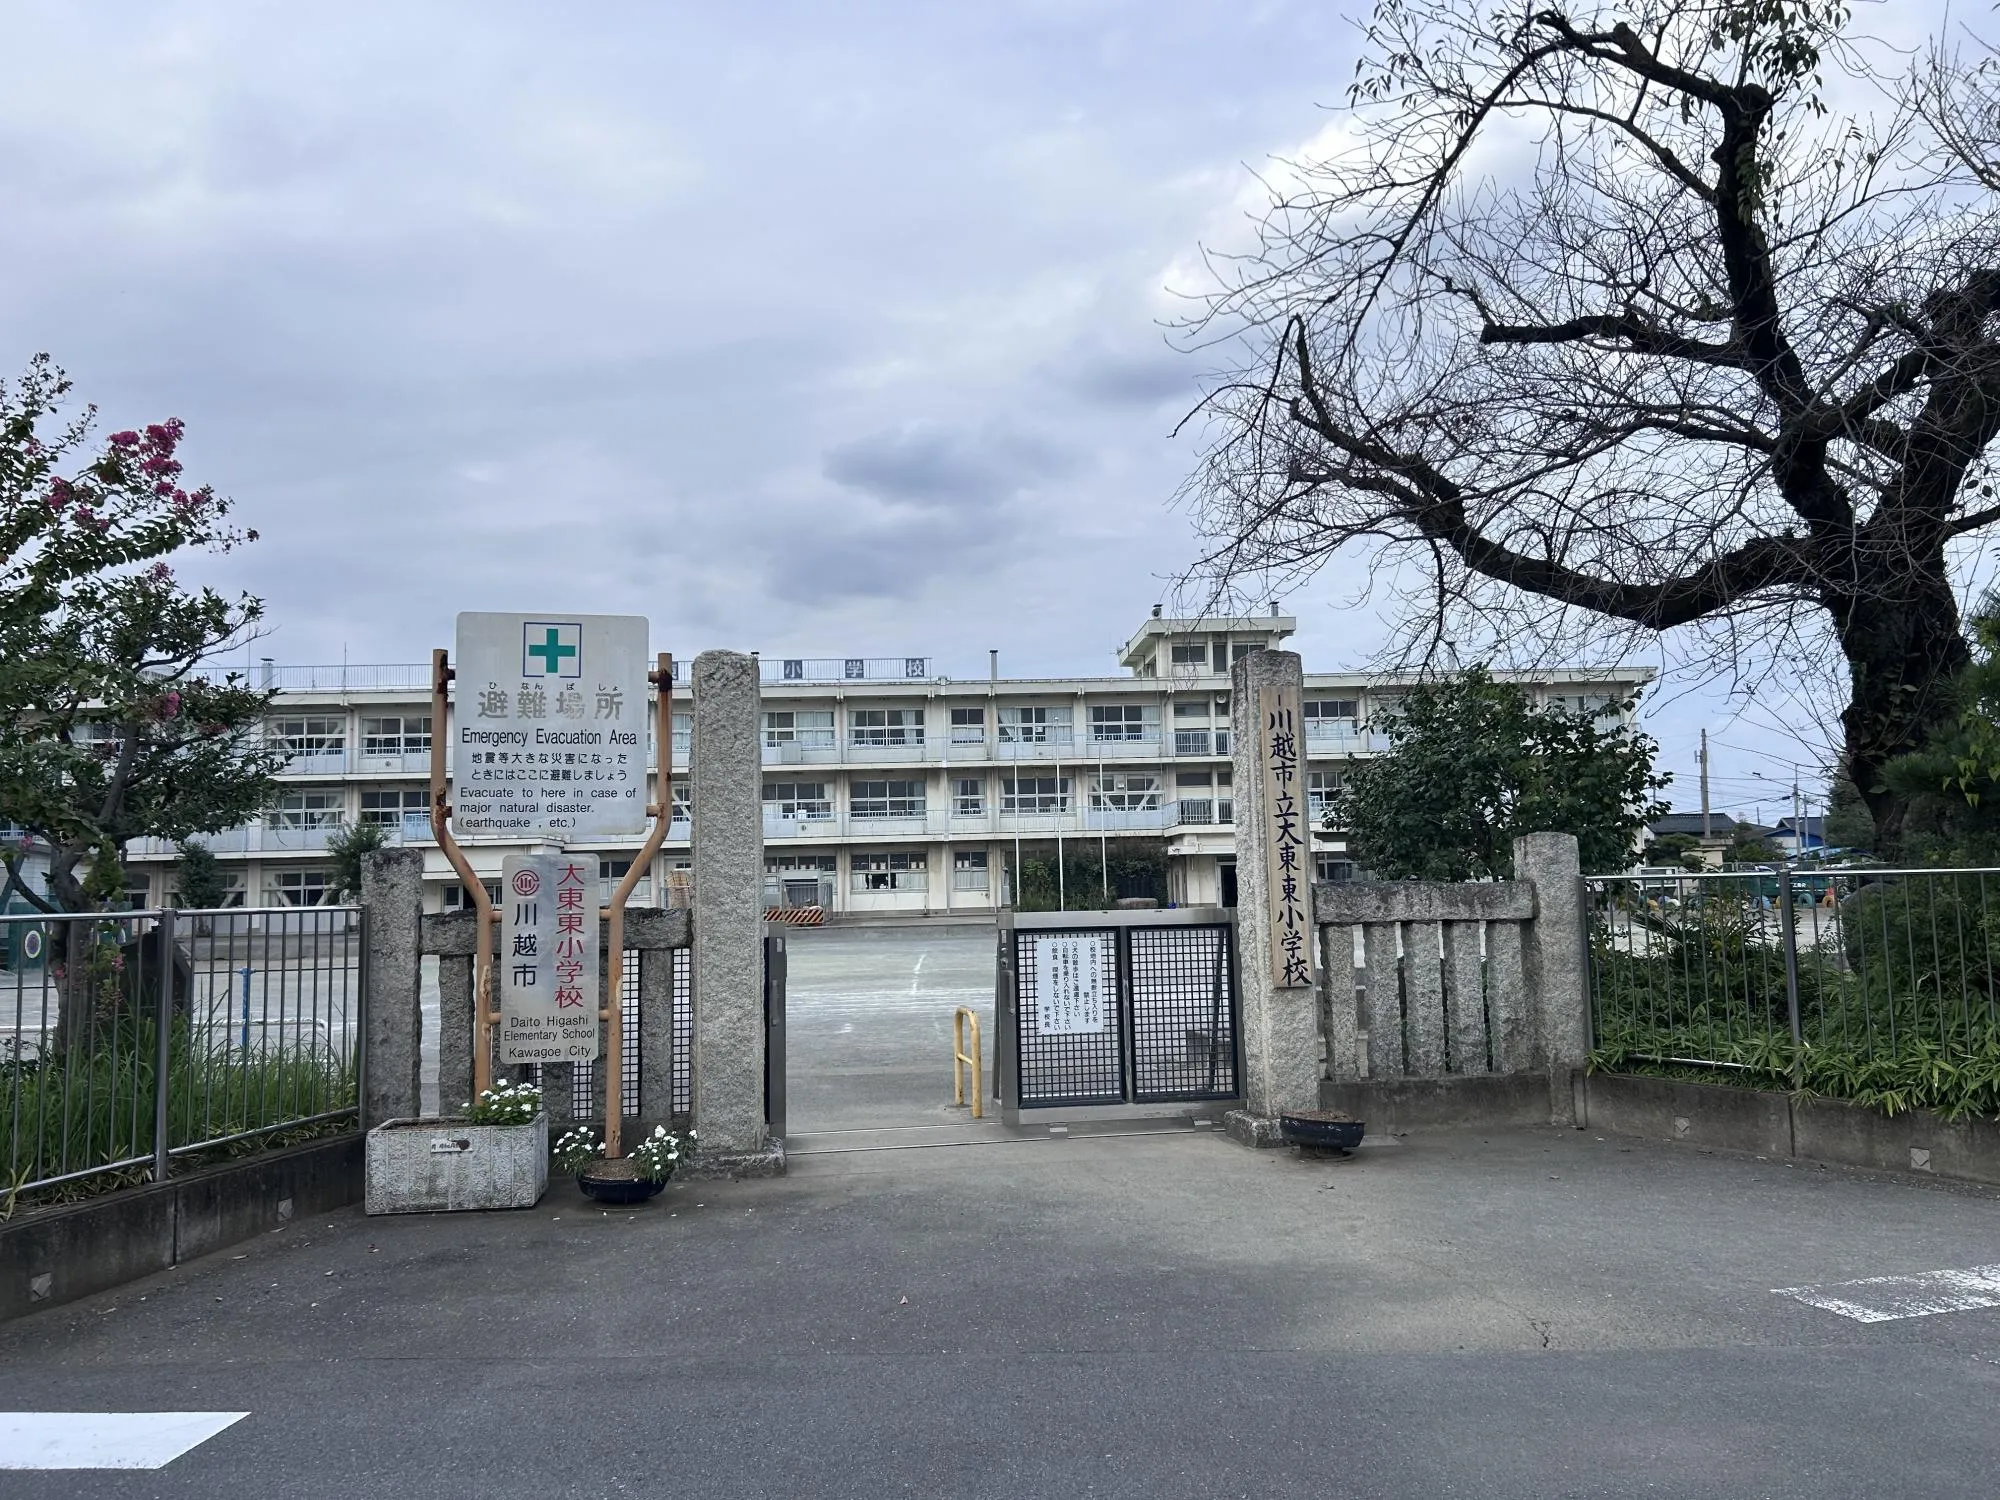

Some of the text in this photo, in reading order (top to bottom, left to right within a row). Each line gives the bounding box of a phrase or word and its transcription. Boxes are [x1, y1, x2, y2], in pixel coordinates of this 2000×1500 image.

[478, 690, 624, 720] 避難場所
[462, 728, 638, 747] Emergency Evacuation Area
[472, 752, 628, 765] 地震等大きな災害になった
[471, 769, 627, 781] ときにはここに避難しましょう
[460, 787, 637, 799] Evacuate to here in case of
[460, 801, 595, 815] major natural disaster.
[1268, 708, 1313, 987] 川越市立大東東小学校
[554, 863, 585, 1009] 大東東小学校
[512, 902, 538, 988] 川越市
[510, 1014, 589, 1028] Daito Higashi
[504, 1028, 595, 1042] Elementary School
[509, 1045, 591, 1059] Kawagoe City
